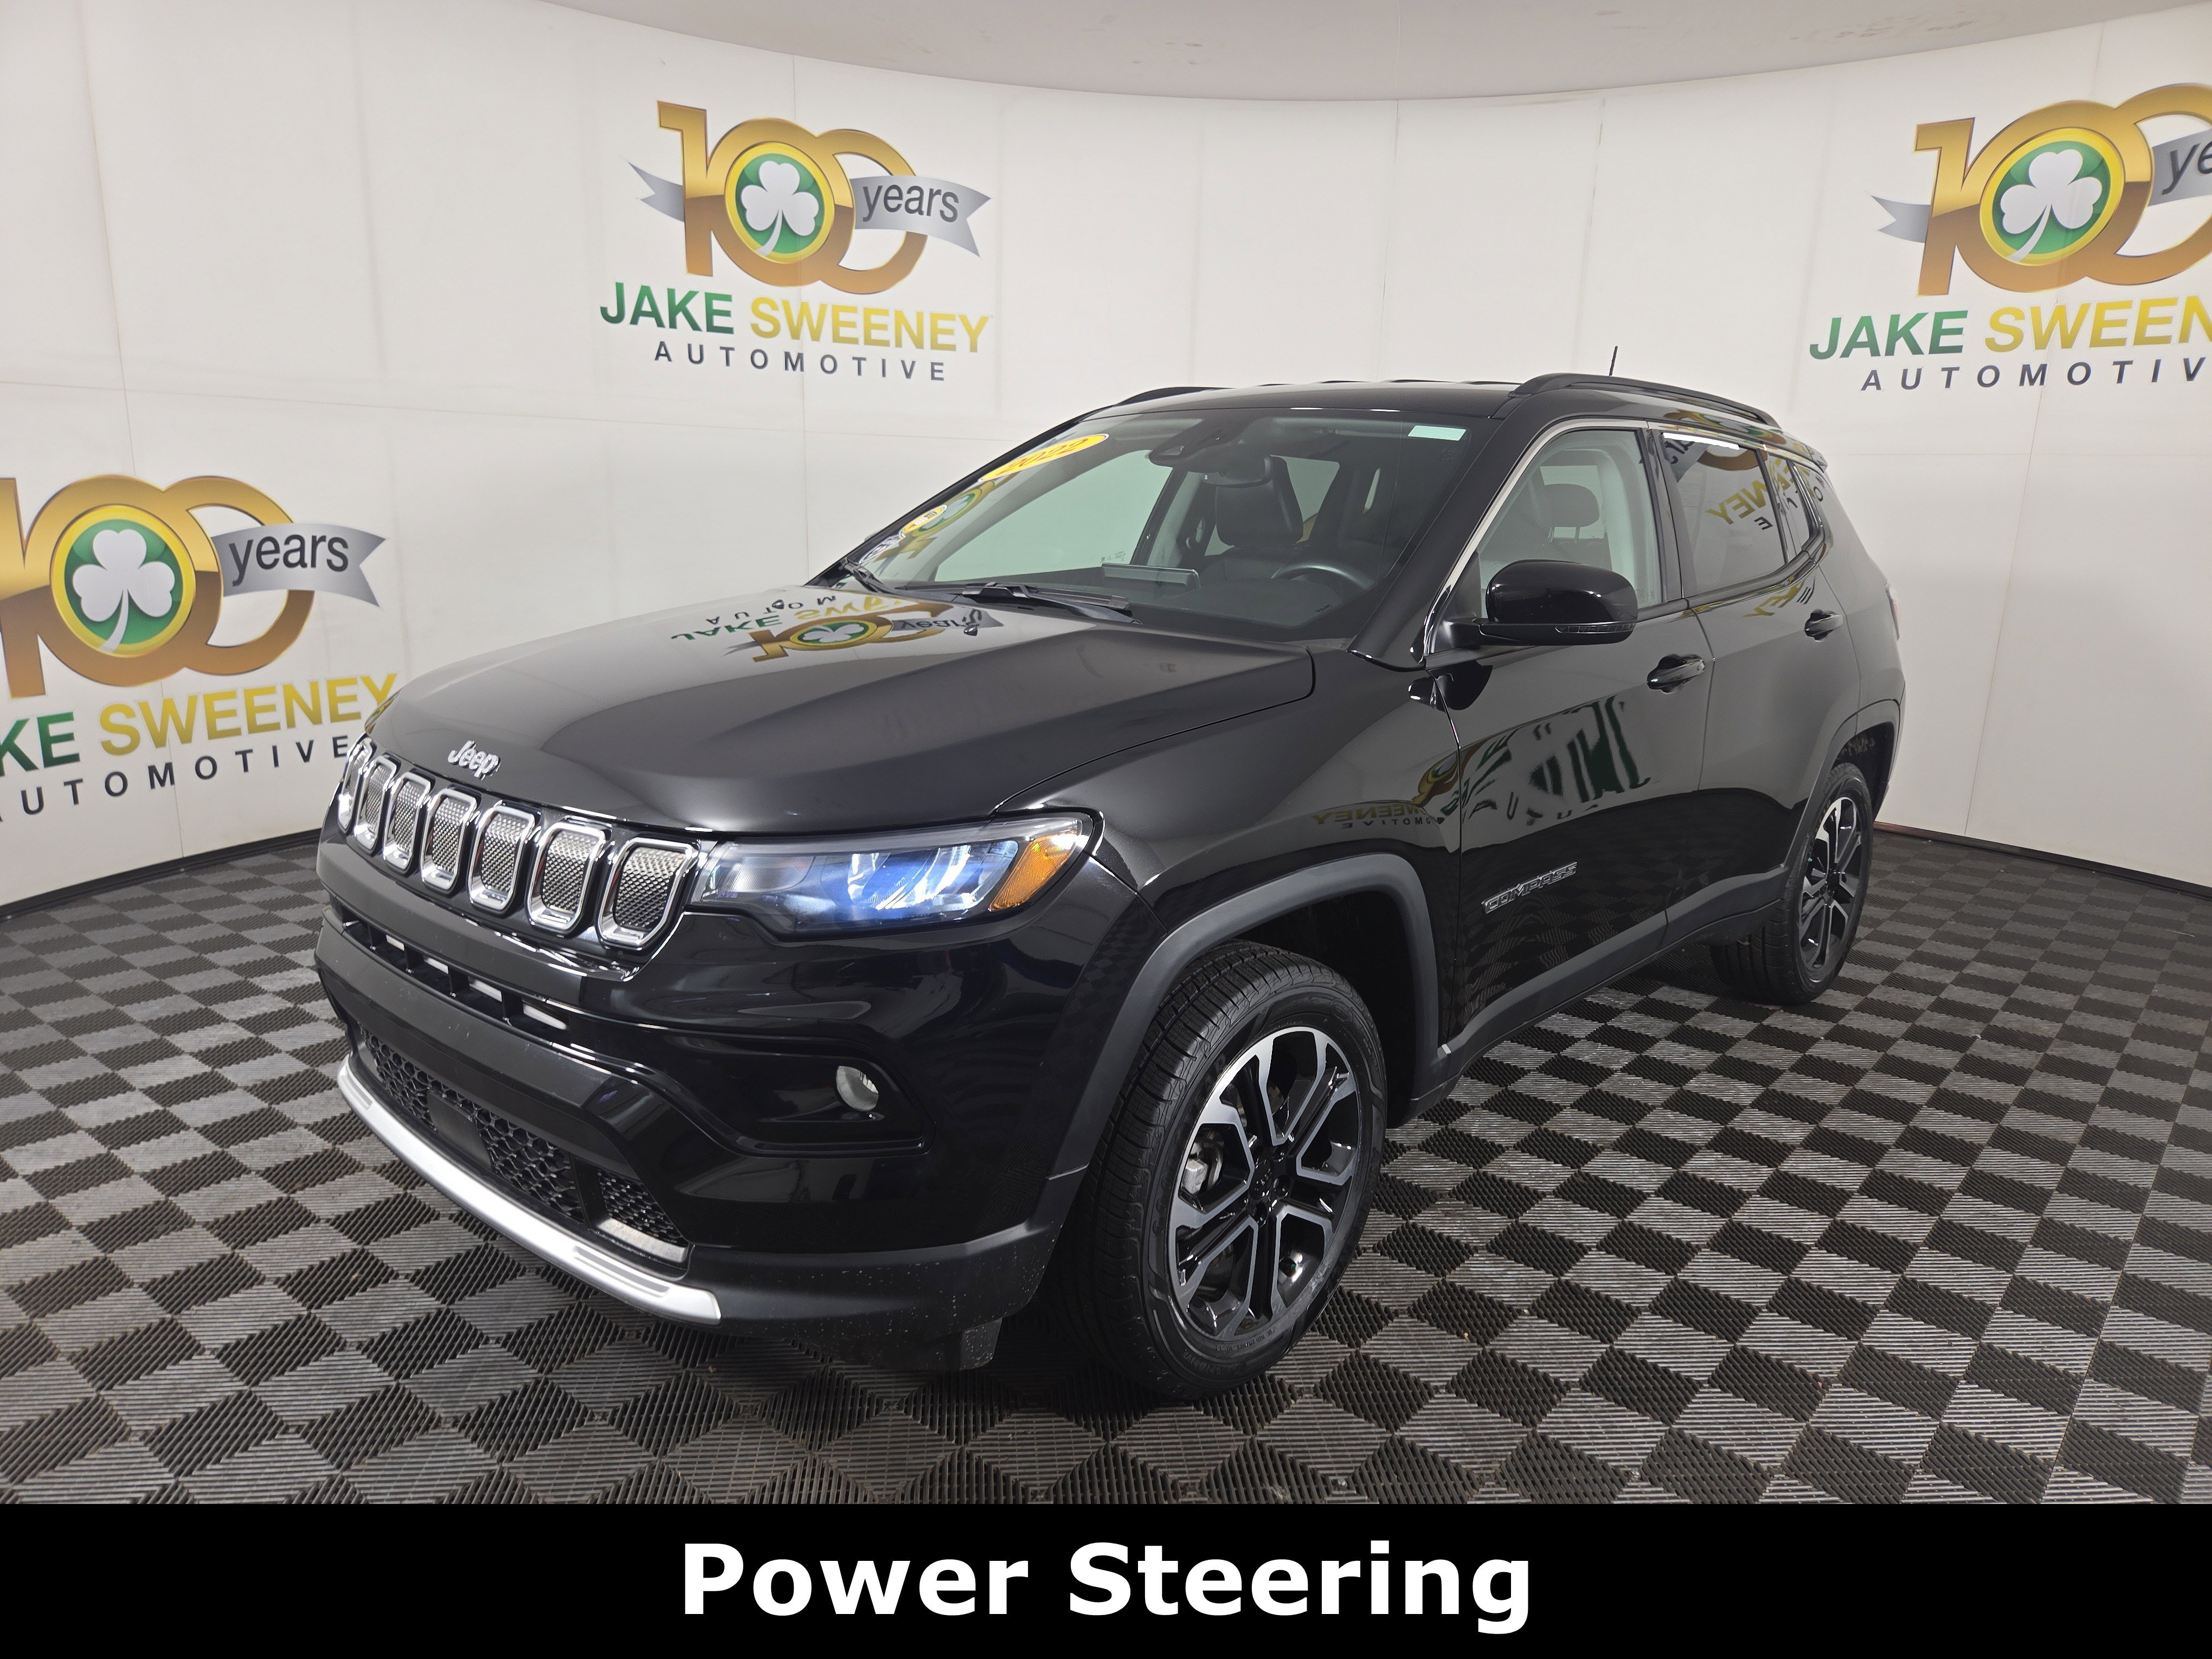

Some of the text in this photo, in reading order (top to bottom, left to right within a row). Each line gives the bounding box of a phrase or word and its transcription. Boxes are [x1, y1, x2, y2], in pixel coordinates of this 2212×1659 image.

[657, 100, 960, 295] 100 years
[600, 281, 990, 353] JAKE SWEENEY
[1809, 295, 2212, 360] JAKE SWEEN
[654, 341, 944, 381] AUTOMOTIVE
[1861, 356, 2207, 391] AUTOMOTIV
[229, 533, 350, 587] years
[0, 673, 398, 777] KE SWEENEY
[0, 735, 348, 822] UTOMOTIVE
[448, 740, 501, 780] Jeep
[1481, 861, 1578, 914] COMPASS
